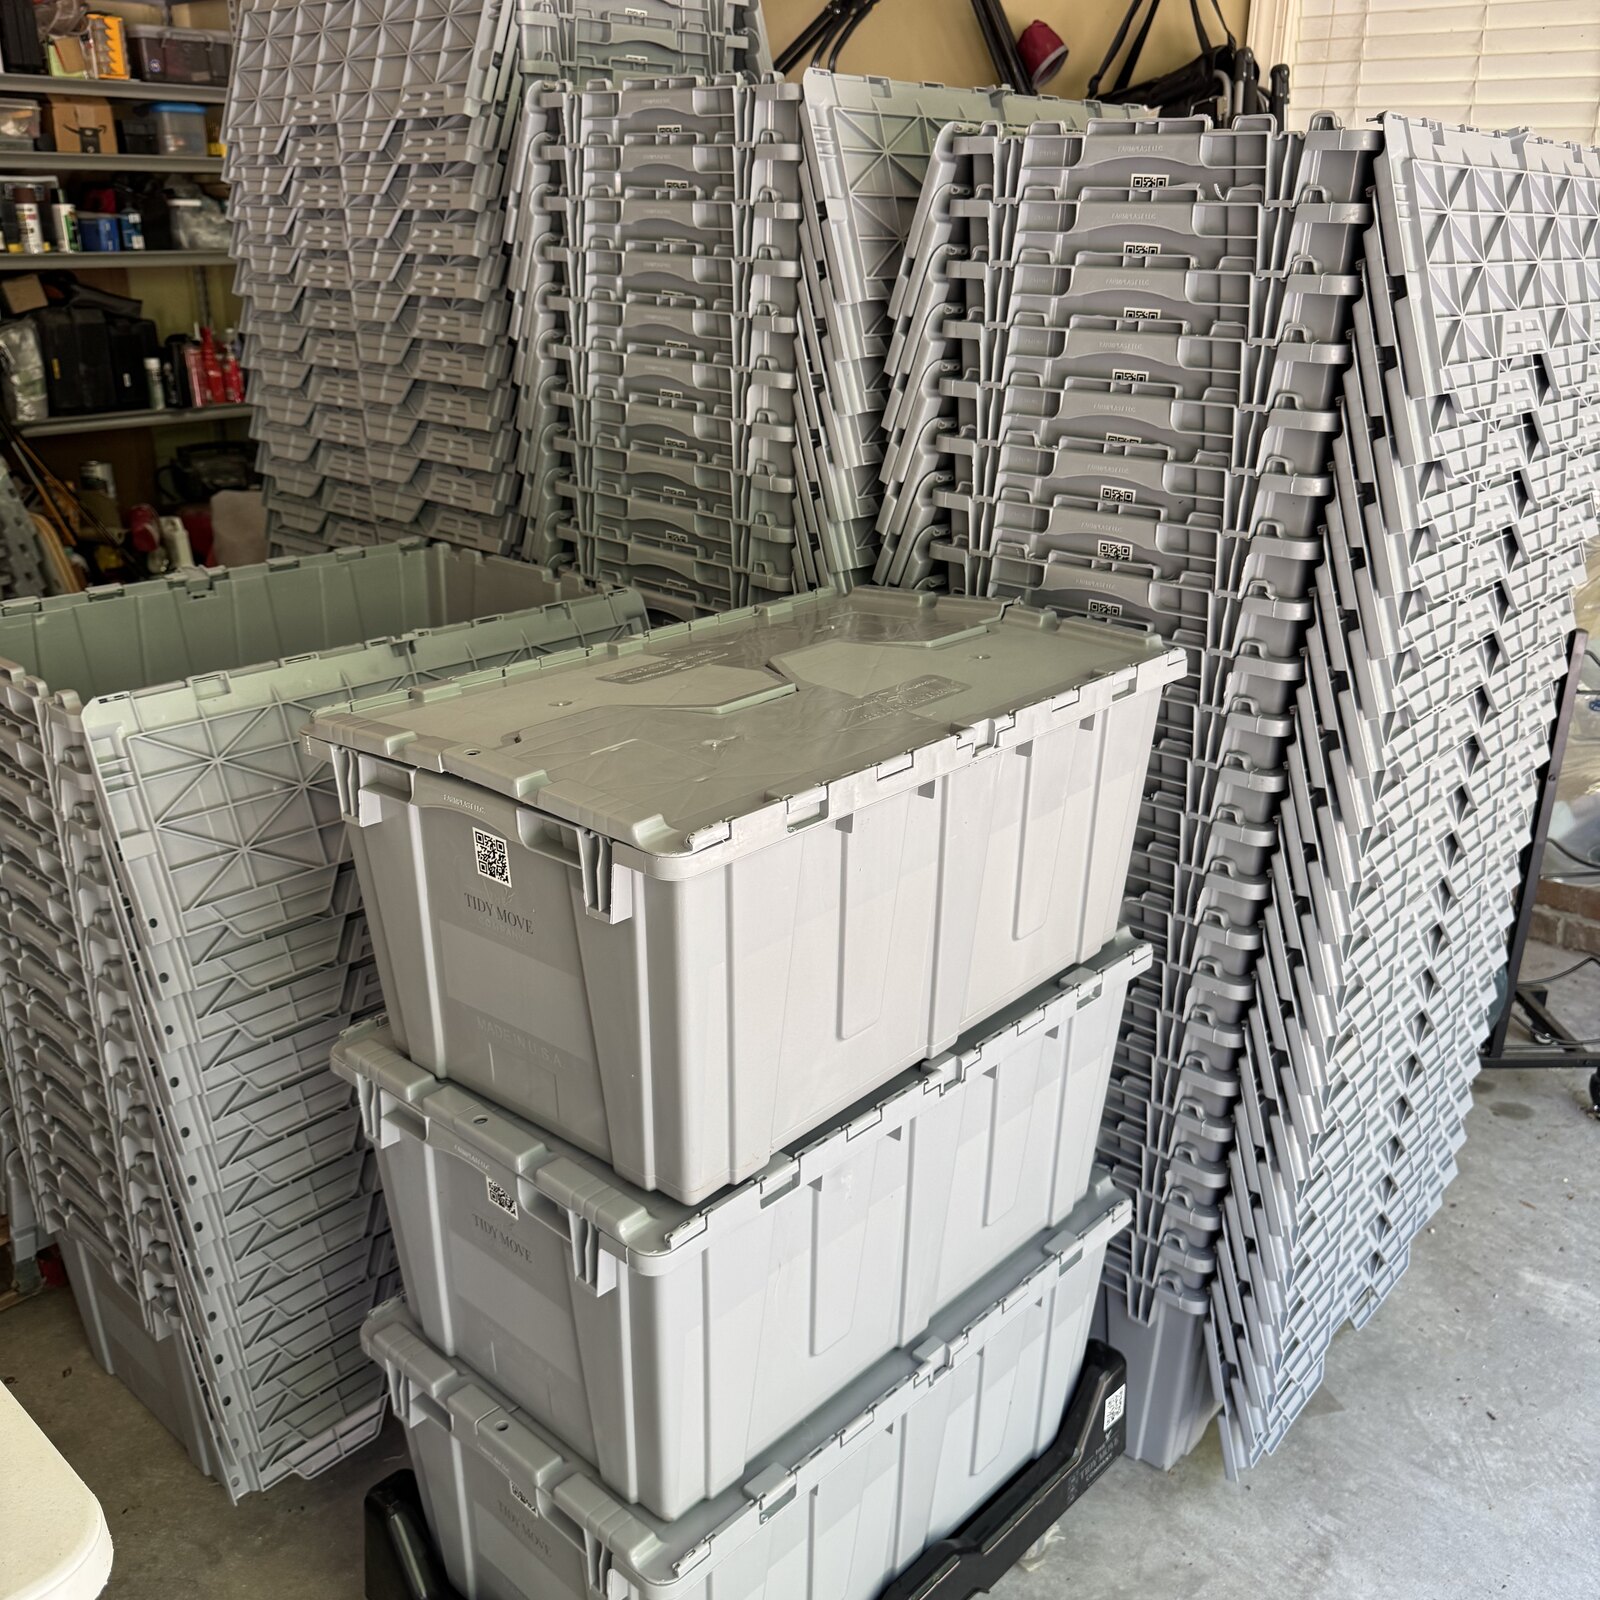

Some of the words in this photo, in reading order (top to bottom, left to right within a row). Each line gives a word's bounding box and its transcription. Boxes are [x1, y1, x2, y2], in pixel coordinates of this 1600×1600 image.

[464, 892, 494, 916] TIDY
[496, 907, 534, 935] MOVE
[477, 1015, 511, 1041] MADE
[472, 1212, 498, 1238] TIDY
[500, 1231, 533, 1263] MOVE
